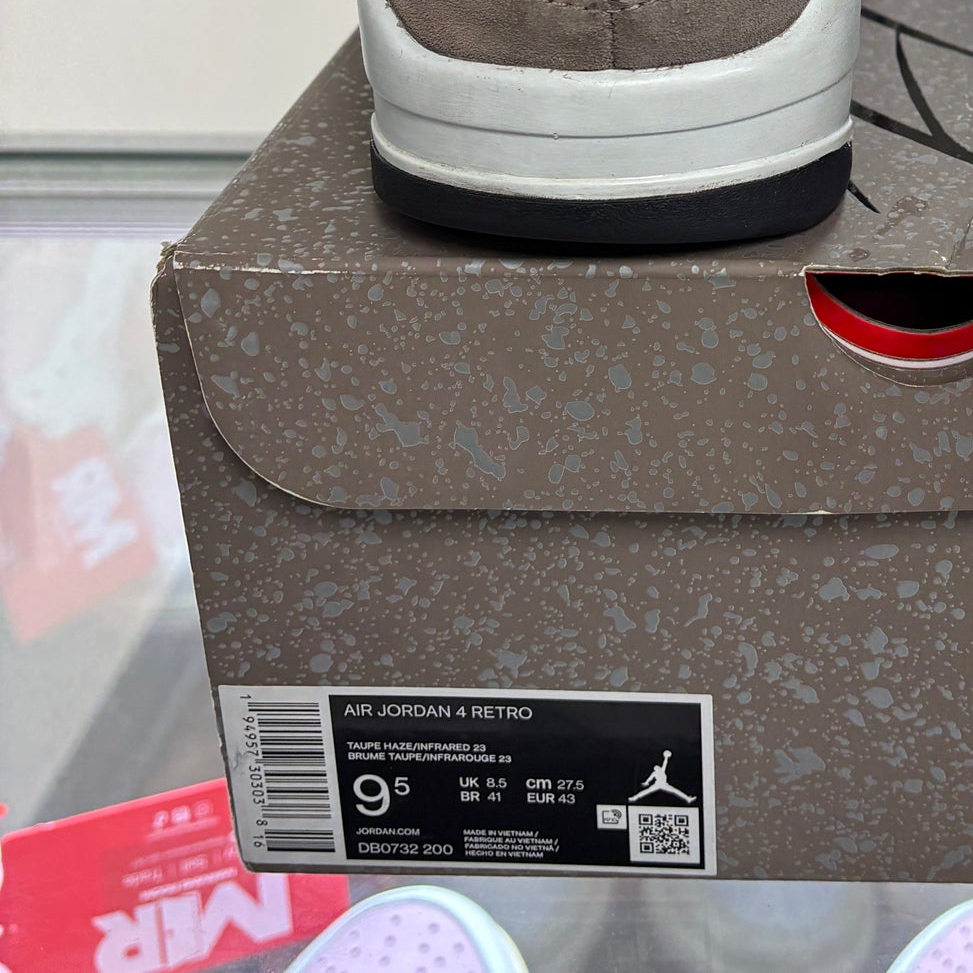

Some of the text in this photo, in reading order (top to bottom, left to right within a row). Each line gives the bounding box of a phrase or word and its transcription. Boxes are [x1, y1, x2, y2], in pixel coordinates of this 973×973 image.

[344, 703, 534, 720] AIR JORDAN 4 RETRO
[242, 716, 259, 757] 94957
[346, 741, 486, 752] TAUPE HAZE/INFRARED 23
[348, 752, 512, 763] BRUME TAUPE/INFRAROUGE 23
[248, 765, 265, 805] 30303
[459, 777, 508, 789] UK 8.5
[526, 779, 584, 791] cm 27.5
[460, 791, 502, 803] BR 41
[527, 793, 576, 804] EUR 43
[356, 827, 420, 836] JORDAN.COM
[517, 837, 553, 845] VIETNAM
[358, 843, 454, 855] DB0732 200
